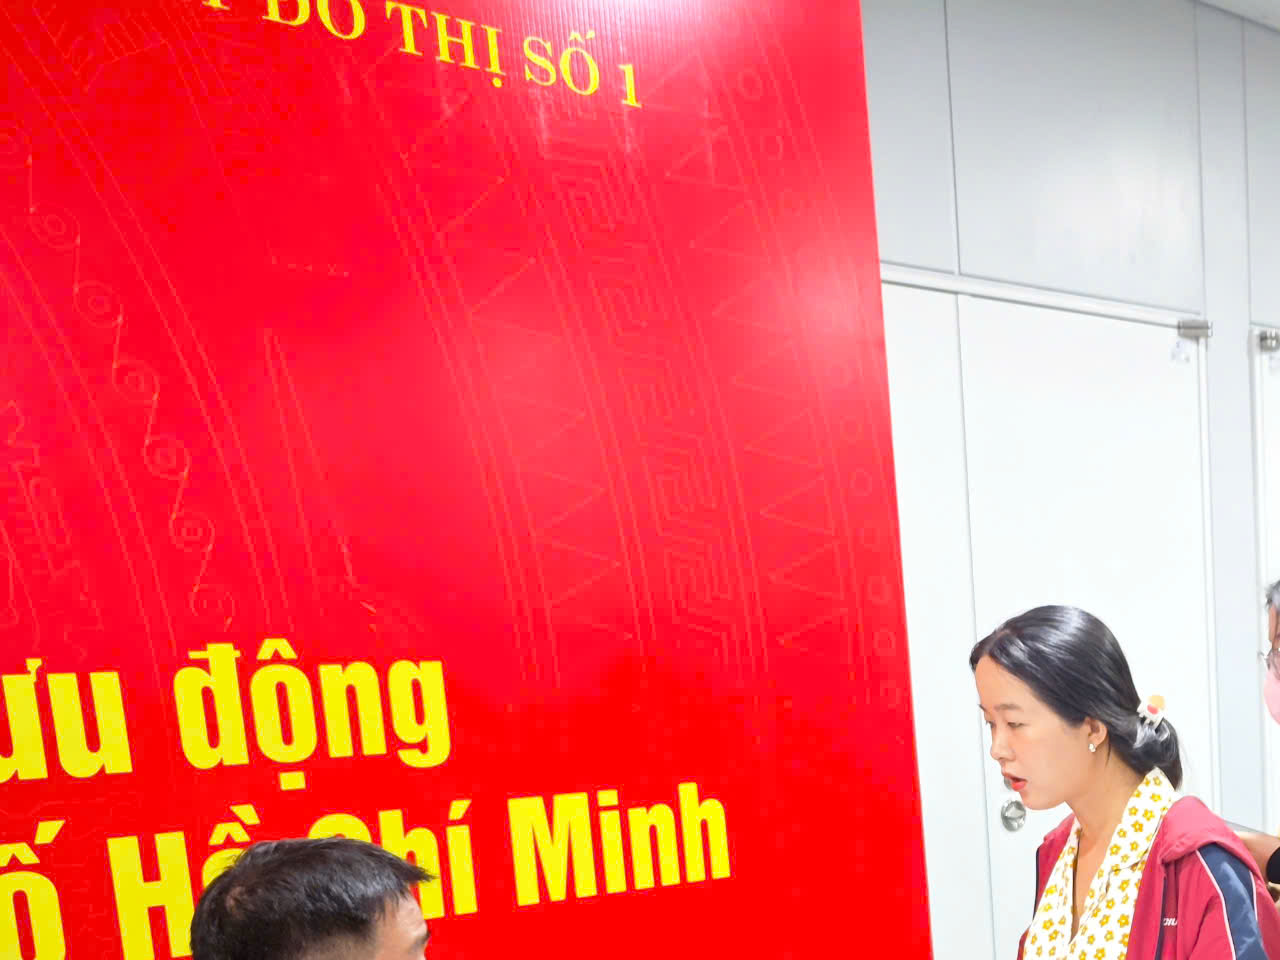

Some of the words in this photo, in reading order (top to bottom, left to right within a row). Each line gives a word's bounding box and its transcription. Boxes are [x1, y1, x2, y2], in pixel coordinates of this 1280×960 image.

[385, 0, 504, 90] THỊ
[523, 29, 601, 97] SỐ
[617, 63, 642, 109] 1
[173, 638, 451, 791] động
[507, 781, 732, 908] Minh
